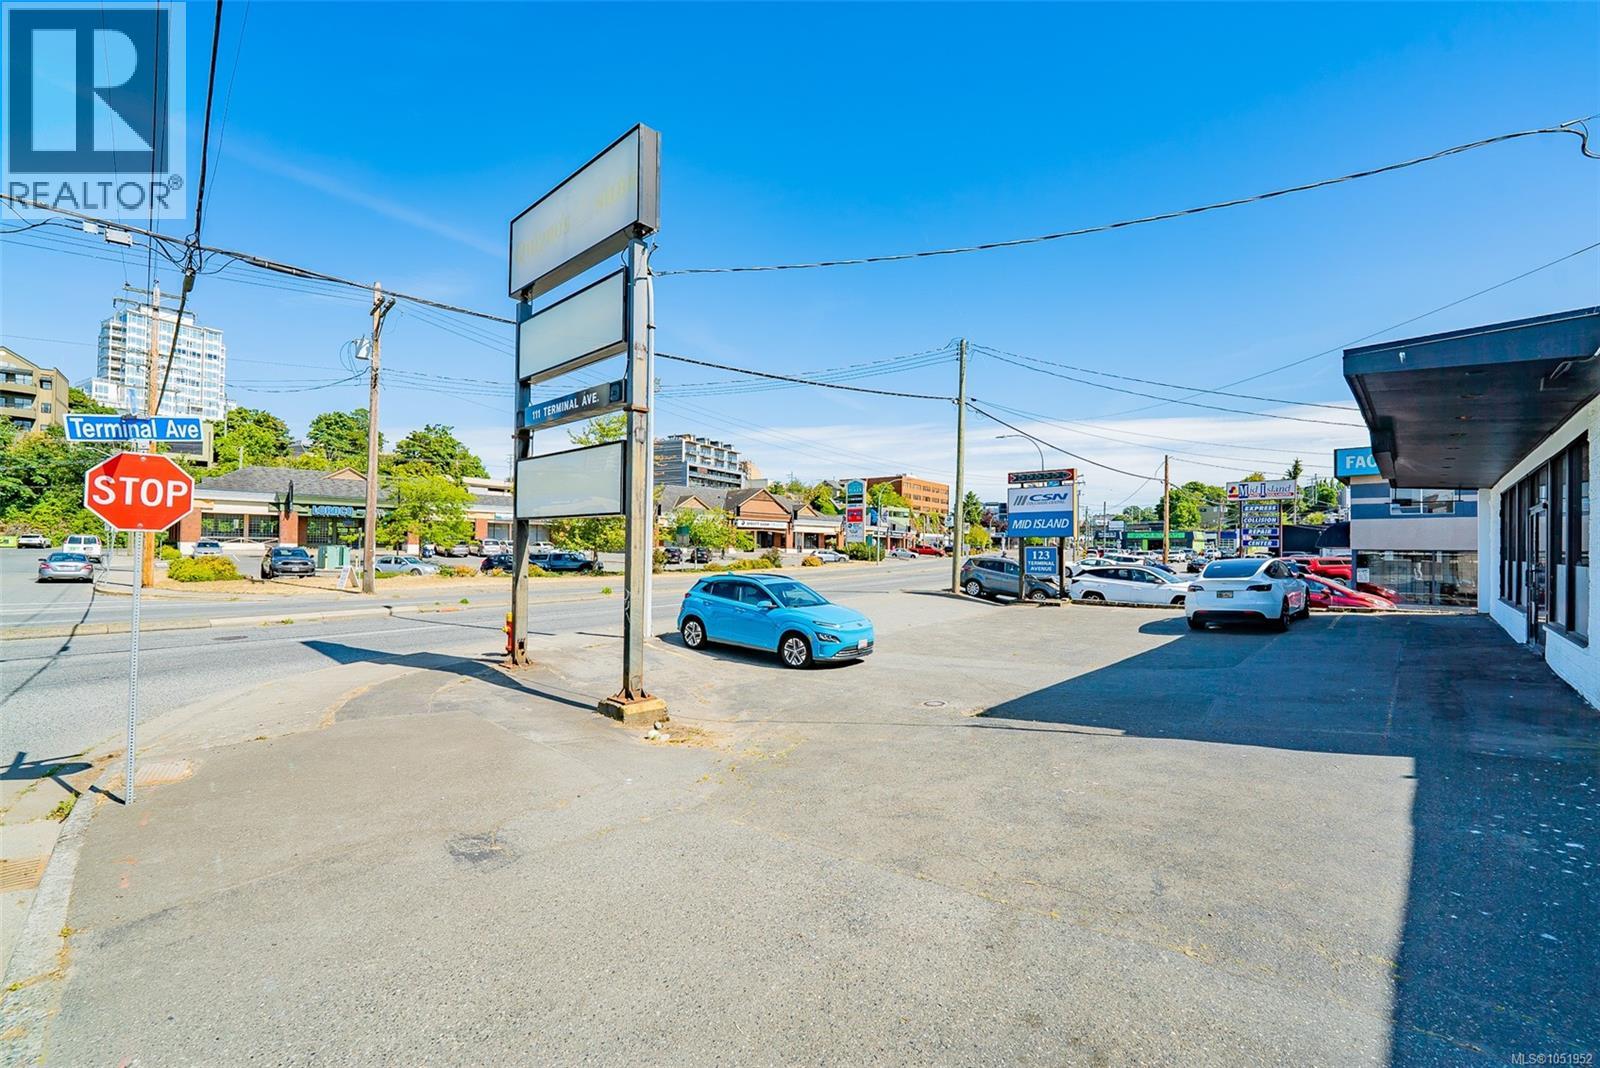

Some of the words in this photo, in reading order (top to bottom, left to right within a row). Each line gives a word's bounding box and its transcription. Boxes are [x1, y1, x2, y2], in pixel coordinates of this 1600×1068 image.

[532, 409, 541, 420] 111
[543, 399, 579, 417] TERMINAL
[581, 392, 600, 407] AVE.
[69, 417, 157, 438] Terminal
[166, 419, 199, 439] Ave
[92, 475, 189, 508] STOP
[1029, 493, 1068, 502] CSN
[1012, 519, 1032, 529] MID
[1033, 518, 1070, 529] ISLAND
[1032, 550, 1050, 560] 123
